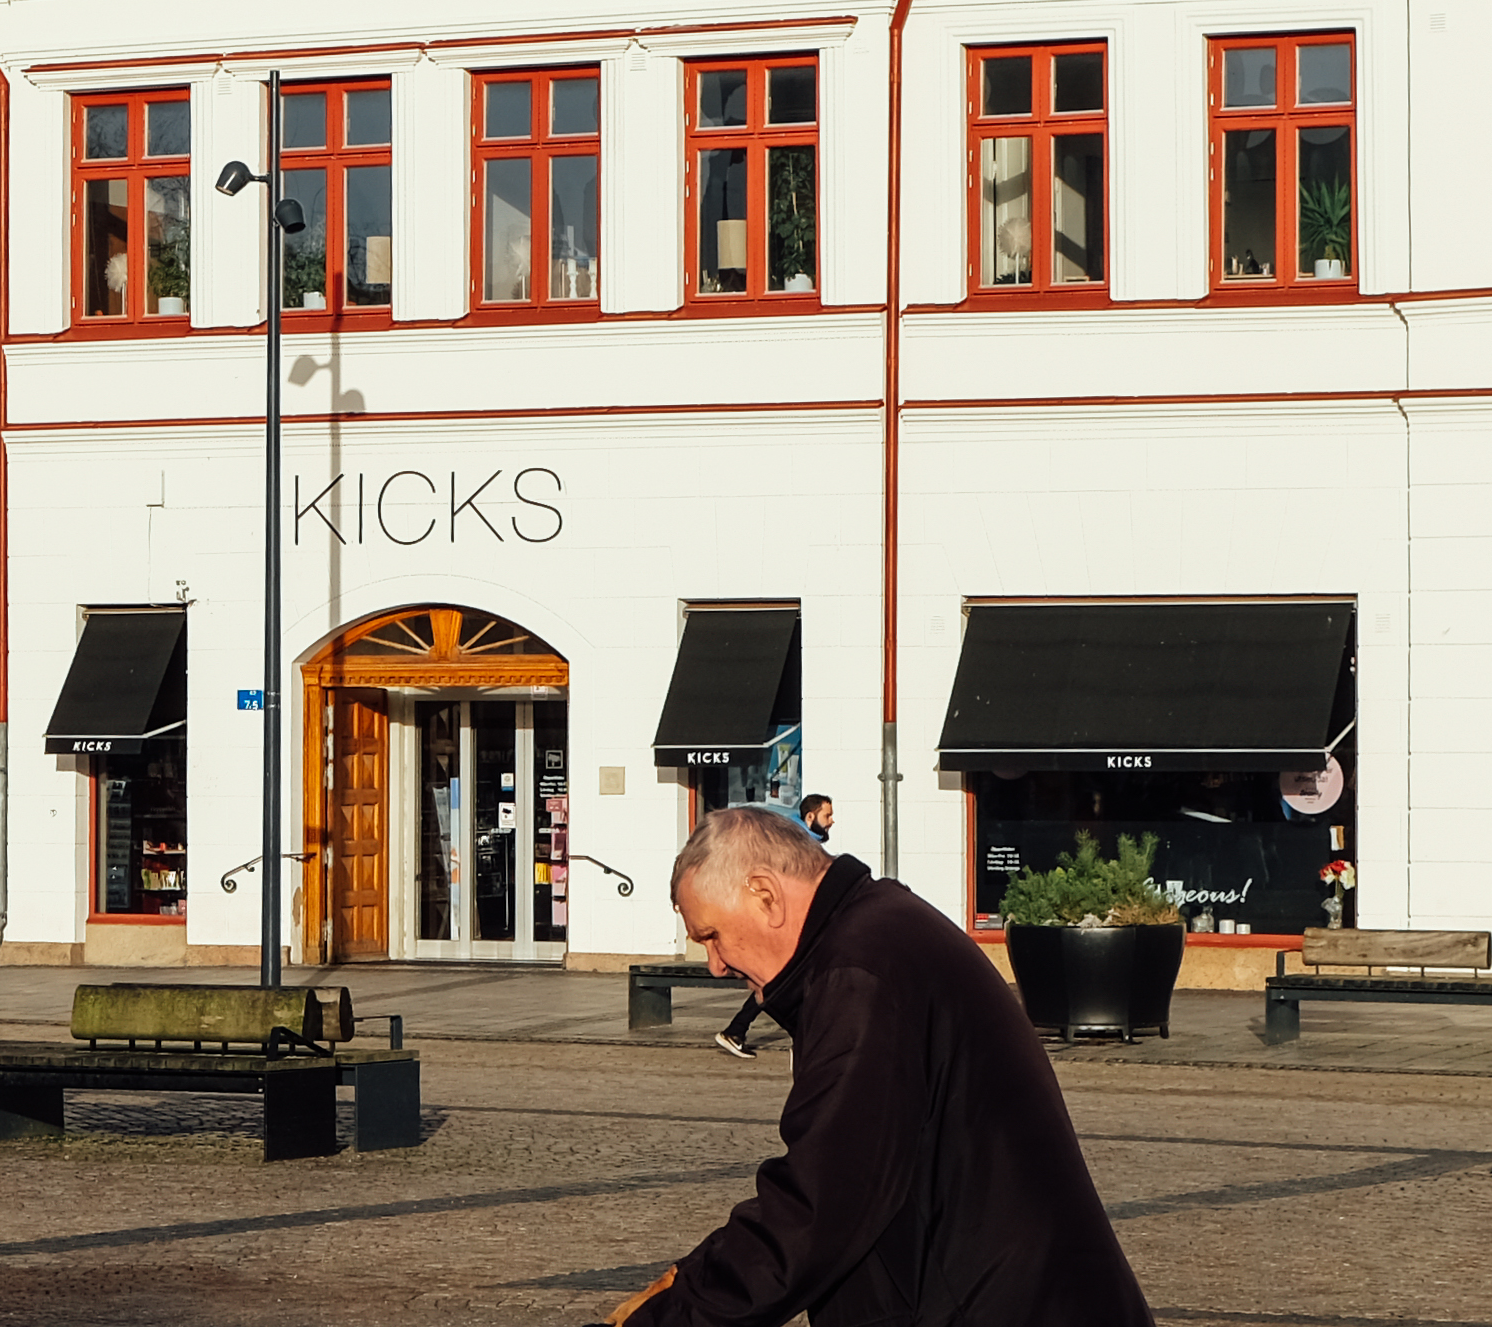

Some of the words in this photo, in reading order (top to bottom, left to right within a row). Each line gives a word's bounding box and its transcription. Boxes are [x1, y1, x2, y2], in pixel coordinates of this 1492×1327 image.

[294, 467, 563, 545] KICKS
[72, 741, 113, 752] KICKS
[686, 752, 731, 765] KICKS
[1106, 756, 1153, 769] KICKS
